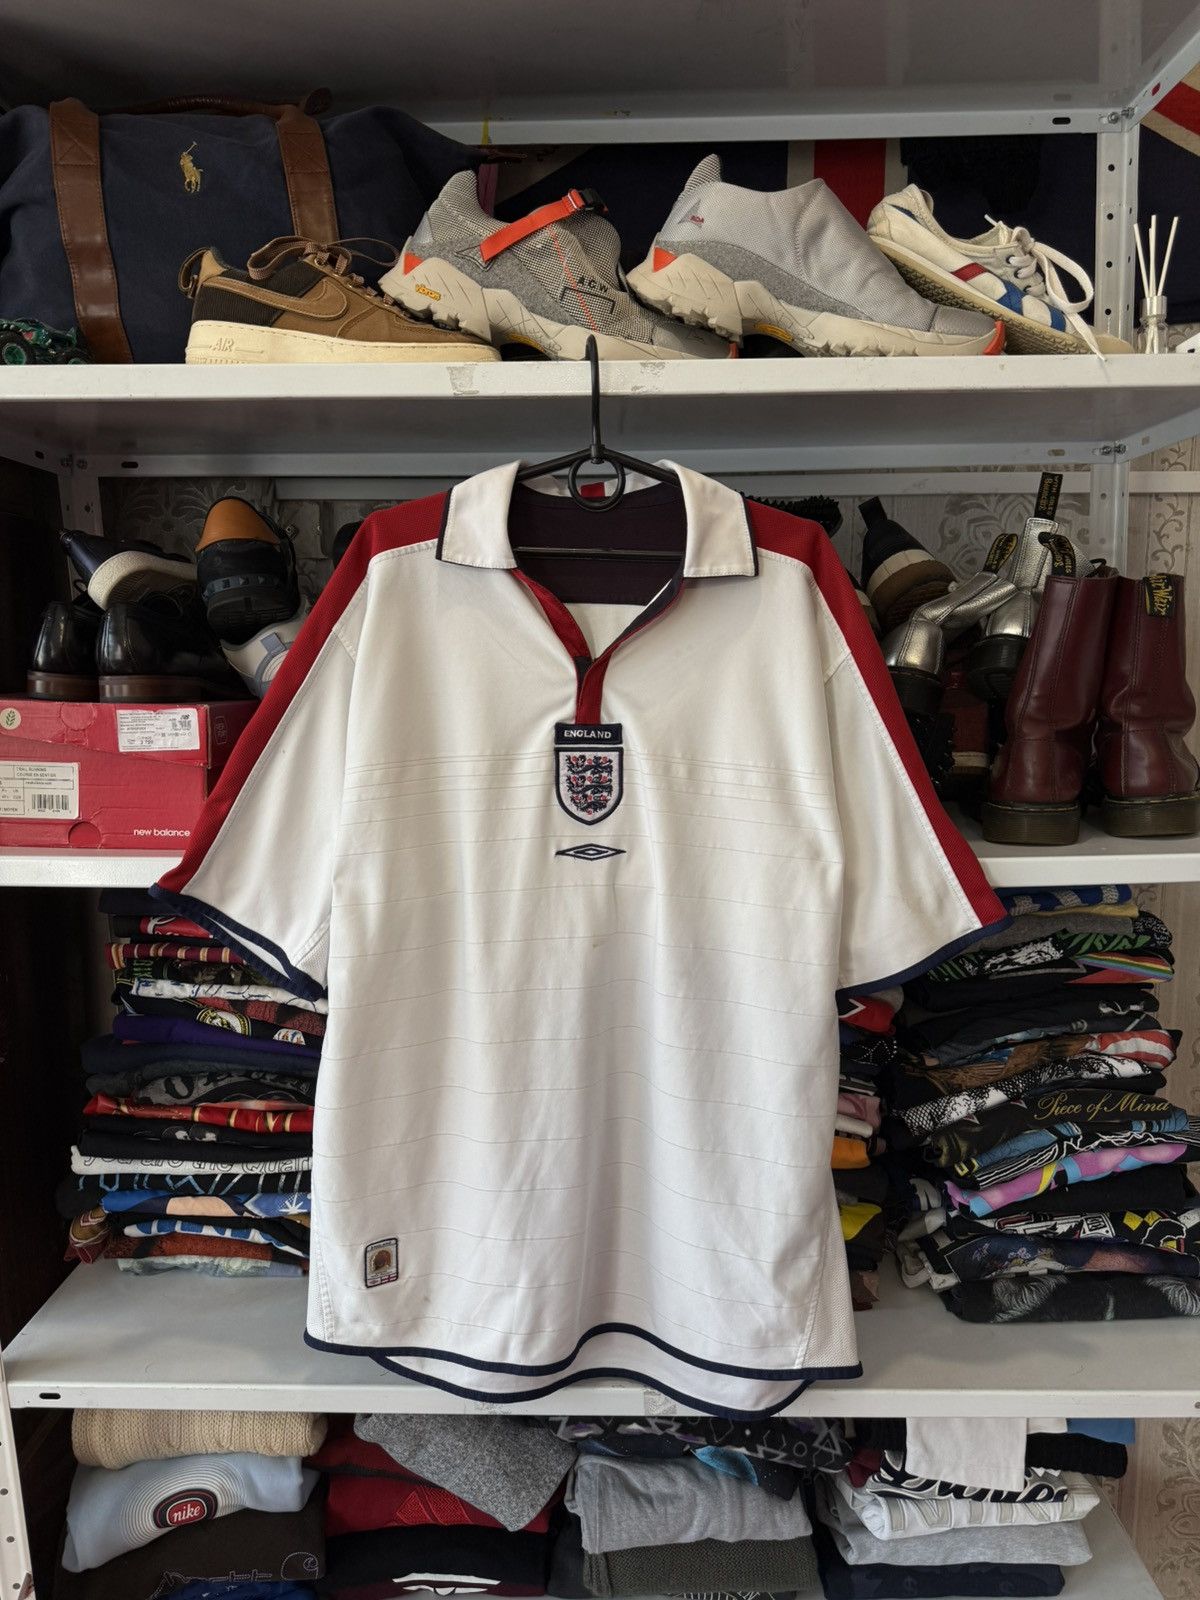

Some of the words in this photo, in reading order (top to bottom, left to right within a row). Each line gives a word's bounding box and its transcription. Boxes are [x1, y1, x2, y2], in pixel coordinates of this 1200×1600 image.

[563, 730, 612, 739] ENGLAND
[153, 828, 191, 837] balance
[1034, 1093, 1083, 1120] Piece
[1086, 1093, 1112, 1121] of
[172, 1503, 201, 1522] nike
